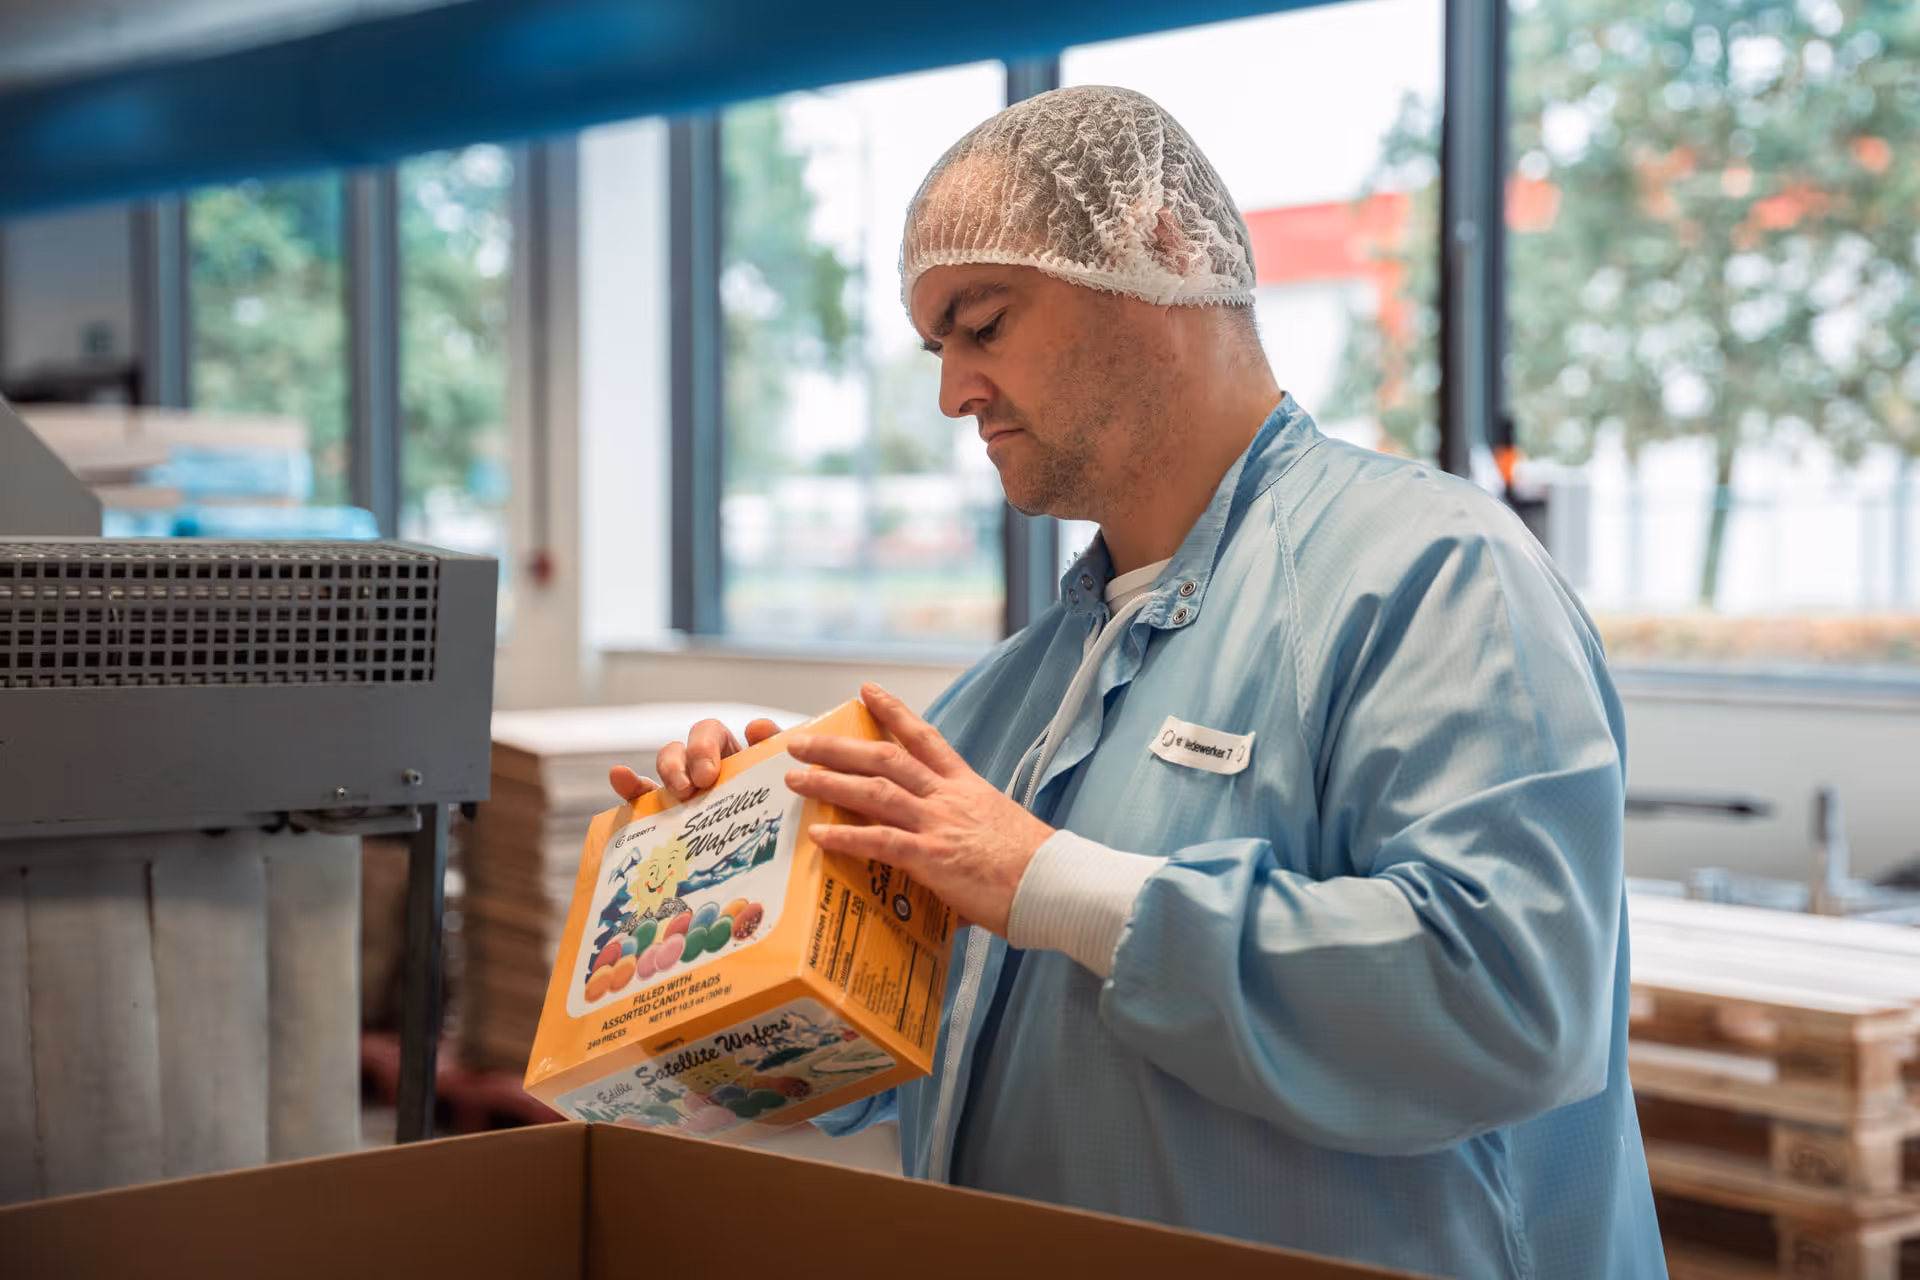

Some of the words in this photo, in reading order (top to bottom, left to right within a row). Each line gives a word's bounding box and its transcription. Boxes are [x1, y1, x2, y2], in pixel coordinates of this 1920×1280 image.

[676, 786, 770, 841] Satellite
[808, 914, 827, 969] Nutrition
[820, 879, 834, 912] Facts
[850, 896, 862, 915] 120
[601, 1003, 651, 1032] ASSORTED
[652, 989, 687, 1011] CANDY
[688, 974, 721, 996] BEADS
[633, 985, 665, 1006] FILLED
[667, 974, 693, 993] WITH
[648, 1010, 664, 1024] NET
[665, 1006, 678, 1018] WT
[587, 1037, 601, 1050] 240
[601, 1027, 627, 1044] PIECES
[597, 1081, 633, 1107] Edible
[635, 1047, 720, 1089] Satellite
[714, 1018, 792, 1054] Wafers
